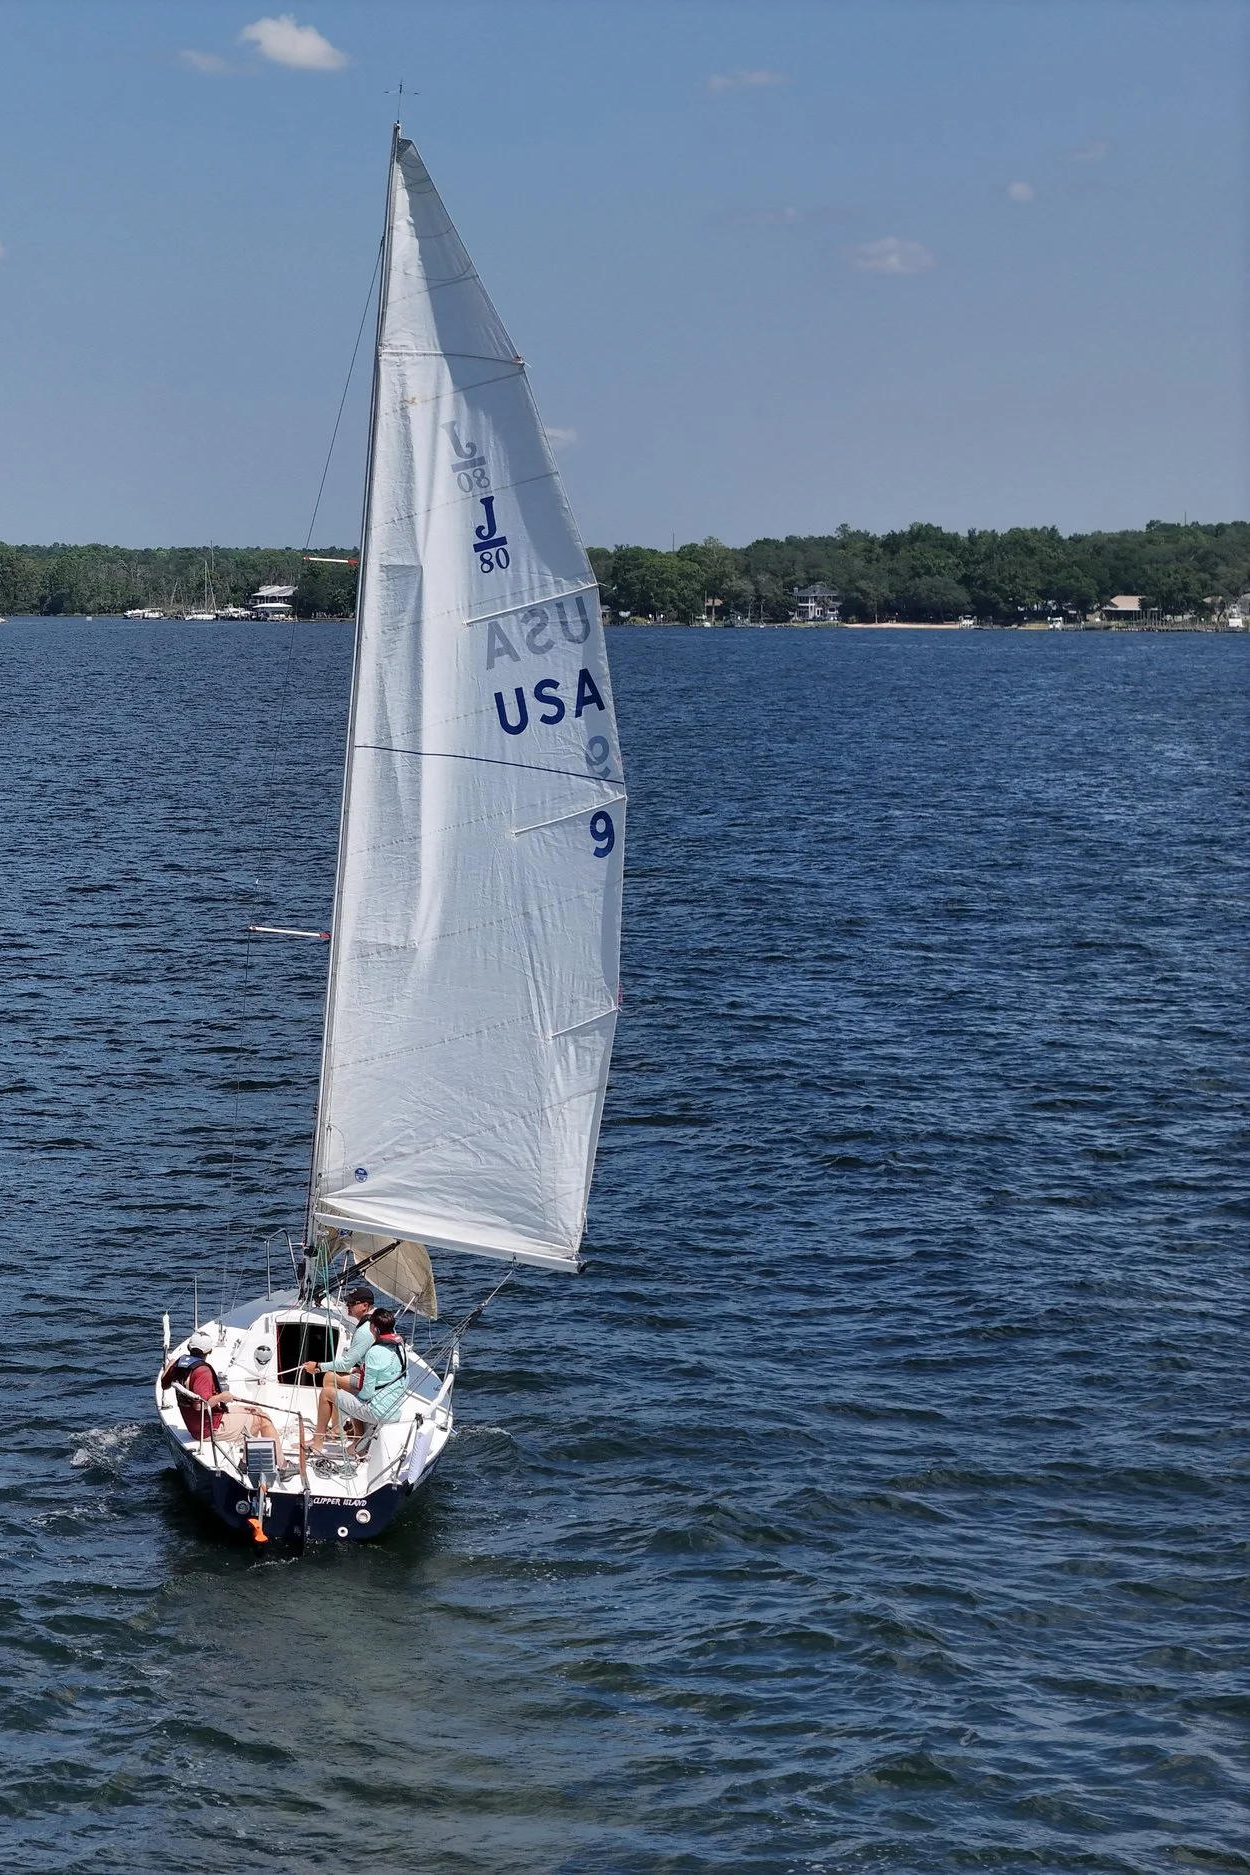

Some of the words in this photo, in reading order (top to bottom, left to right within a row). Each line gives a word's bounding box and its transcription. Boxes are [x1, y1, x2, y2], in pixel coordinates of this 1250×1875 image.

[475, 496, 497, 541] J
[479, 548, 510, 574] 80
[494, 668, 606, 735] USA
[590, 810, 615, 858] 9
[313, 1497, 341, 1506] CLIPPER
